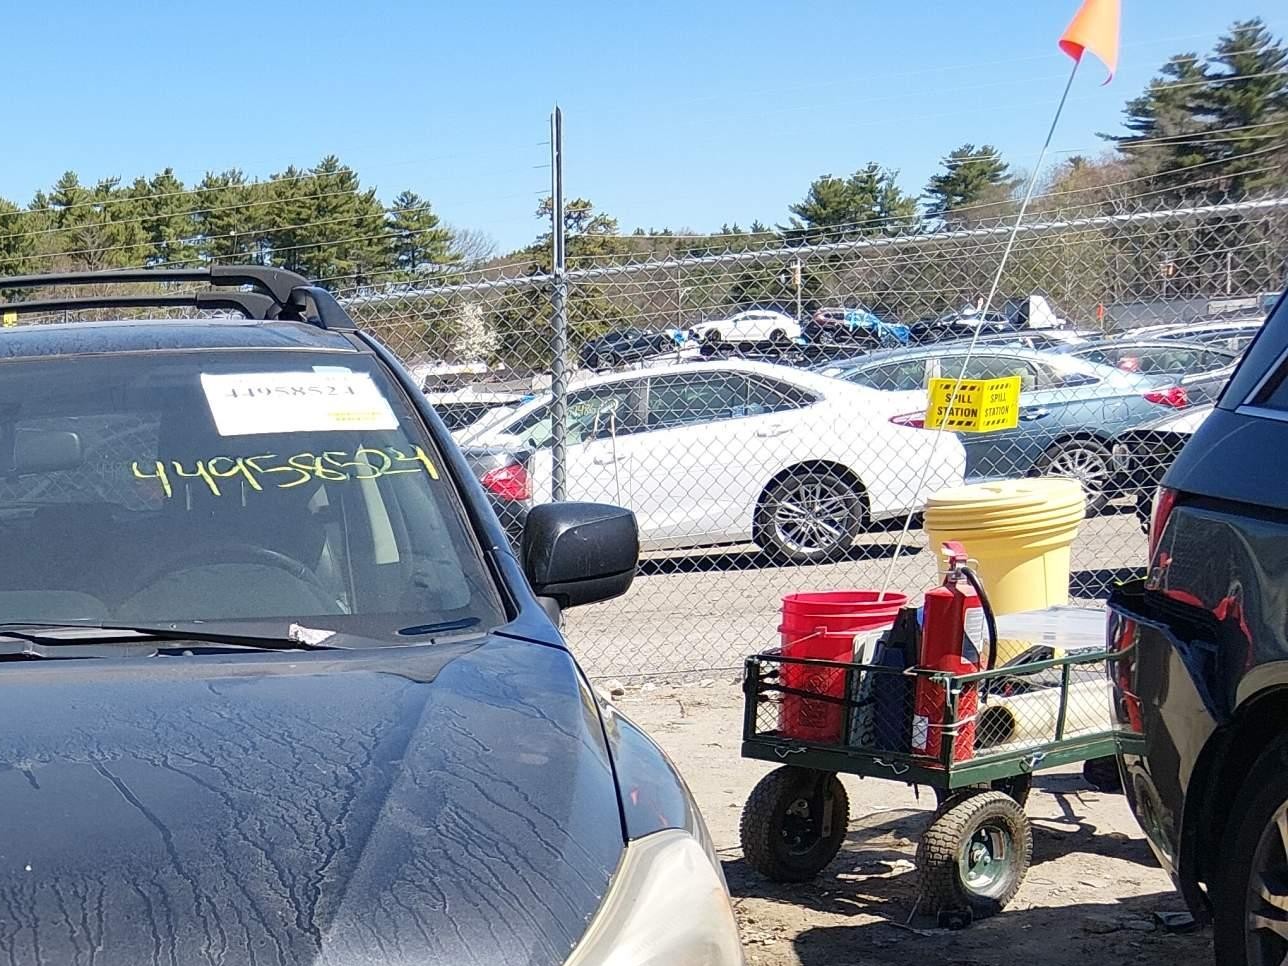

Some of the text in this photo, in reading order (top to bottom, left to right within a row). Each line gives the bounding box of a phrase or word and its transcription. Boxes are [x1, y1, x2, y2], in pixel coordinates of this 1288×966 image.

[945, 393, 972, 404] SPILL
[990, 392, 1007, 404] SPILL
[937, 406, 978, 418] STATION
[984, 405, 1009, 418] STATION
[132, 443, 440, 498] 44958524
